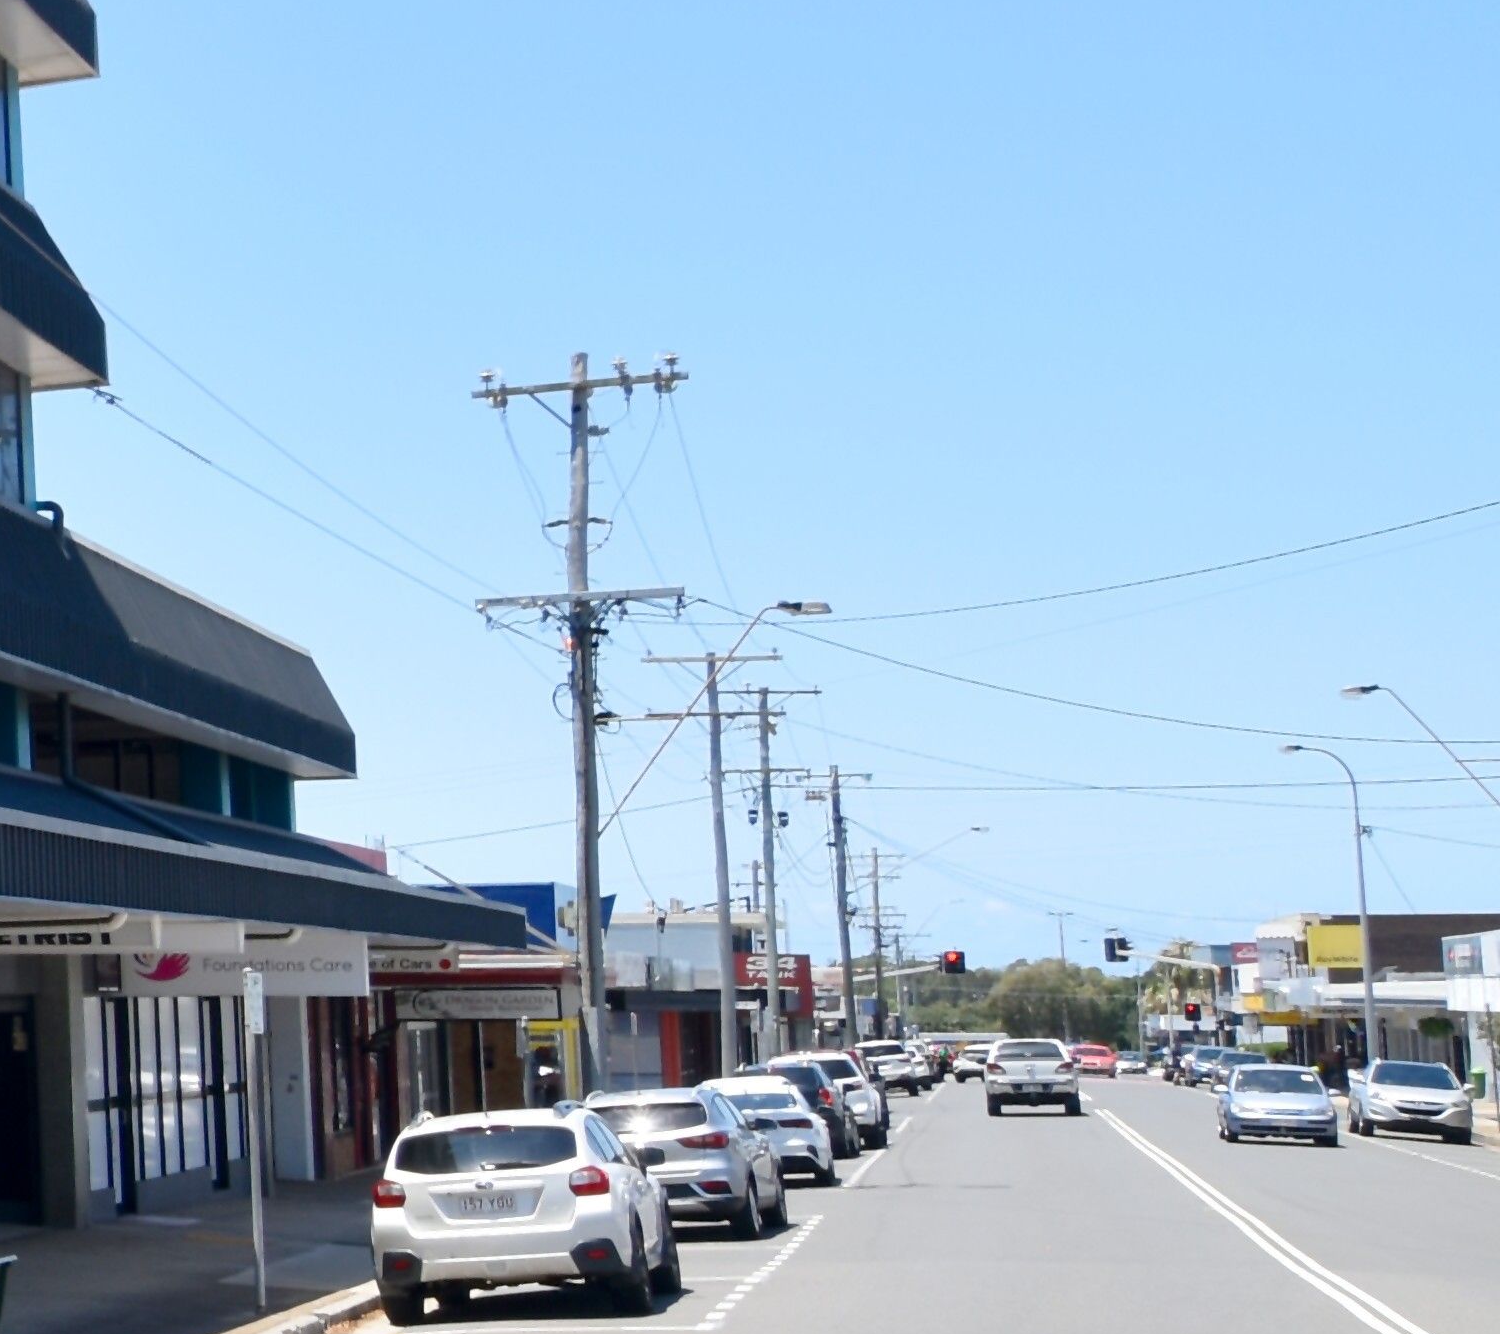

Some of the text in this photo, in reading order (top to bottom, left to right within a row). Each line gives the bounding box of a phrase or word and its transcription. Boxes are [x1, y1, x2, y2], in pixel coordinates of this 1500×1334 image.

[313, 957, 353, 972] Care
[380, 958, 395, 969] of
[400, 958, 432, 969] Cars
[502, 993, 555, 1005] GARDEN
